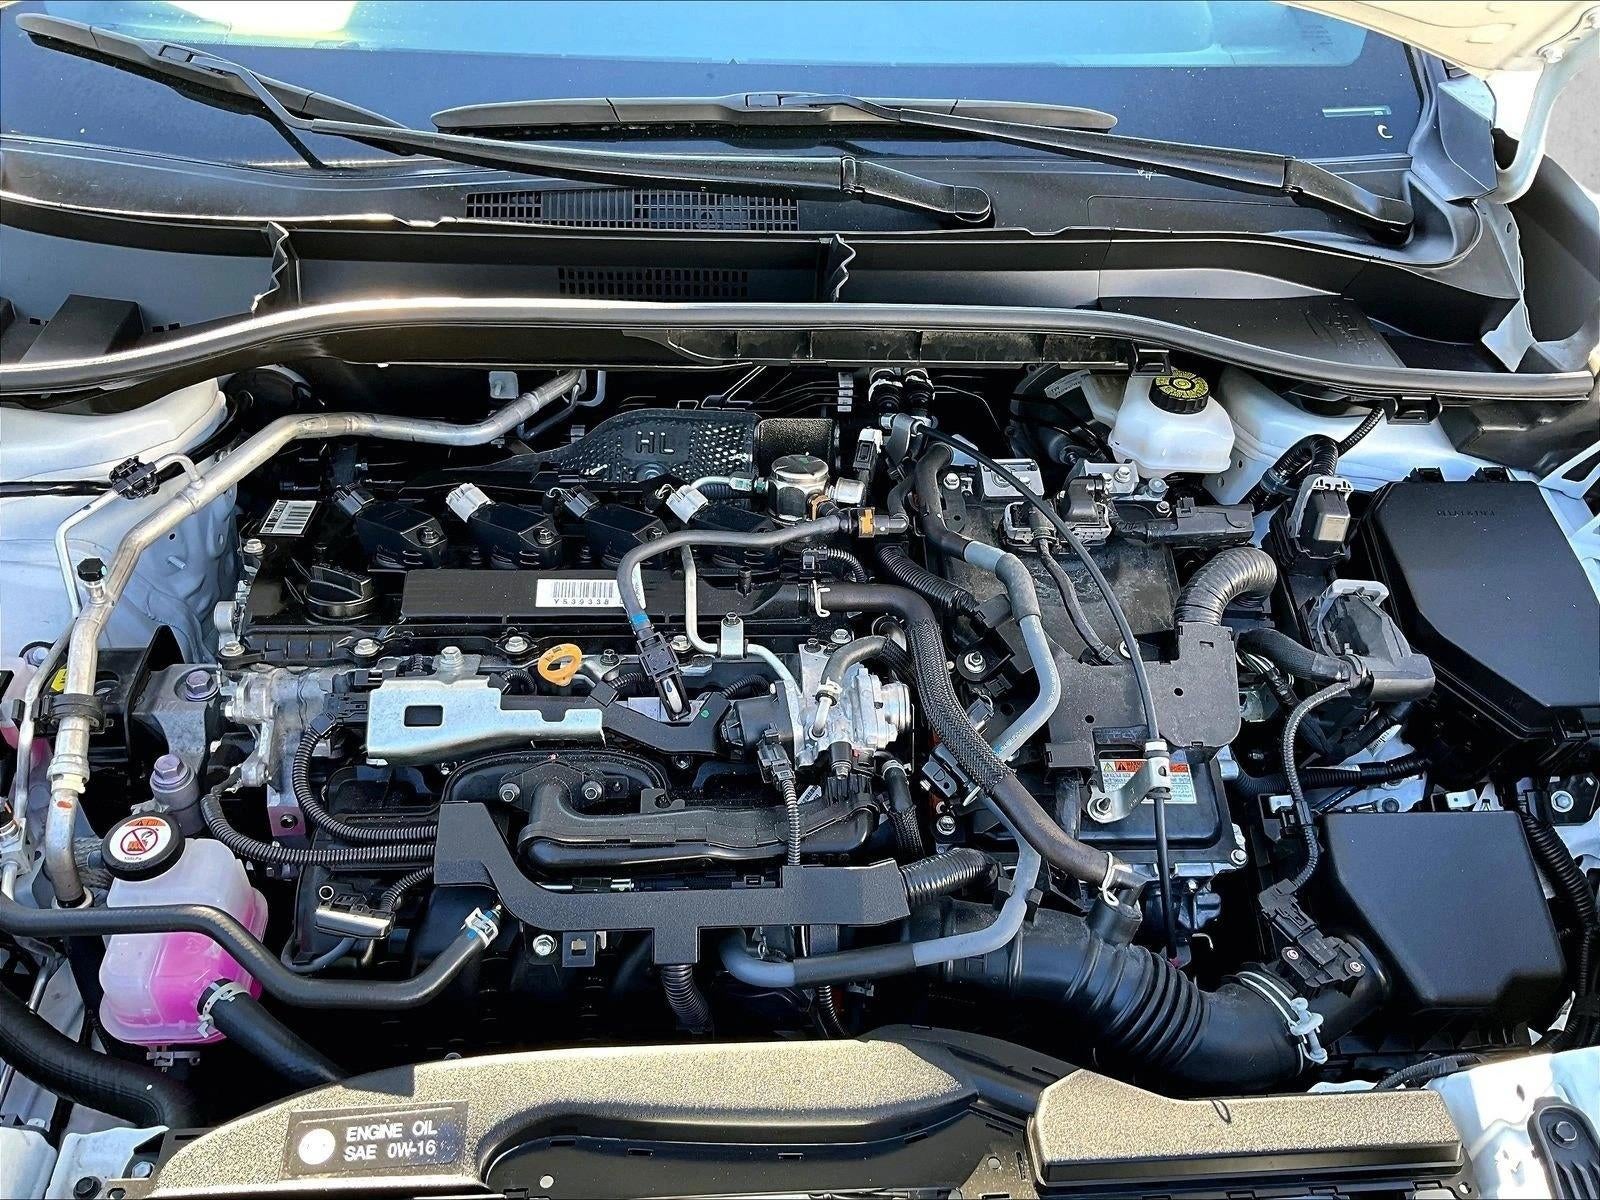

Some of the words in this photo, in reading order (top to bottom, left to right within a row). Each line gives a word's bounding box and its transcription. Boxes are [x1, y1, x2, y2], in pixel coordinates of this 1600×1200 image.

[636, 431, 675, 455] HL
[346, 1122, 403, 1142] ENGINE
[412, 1119, 438, 1136] OIL
[344, 1144, 377, 1161] SAE
[387, 1139, 436, 1158] 0W-16
